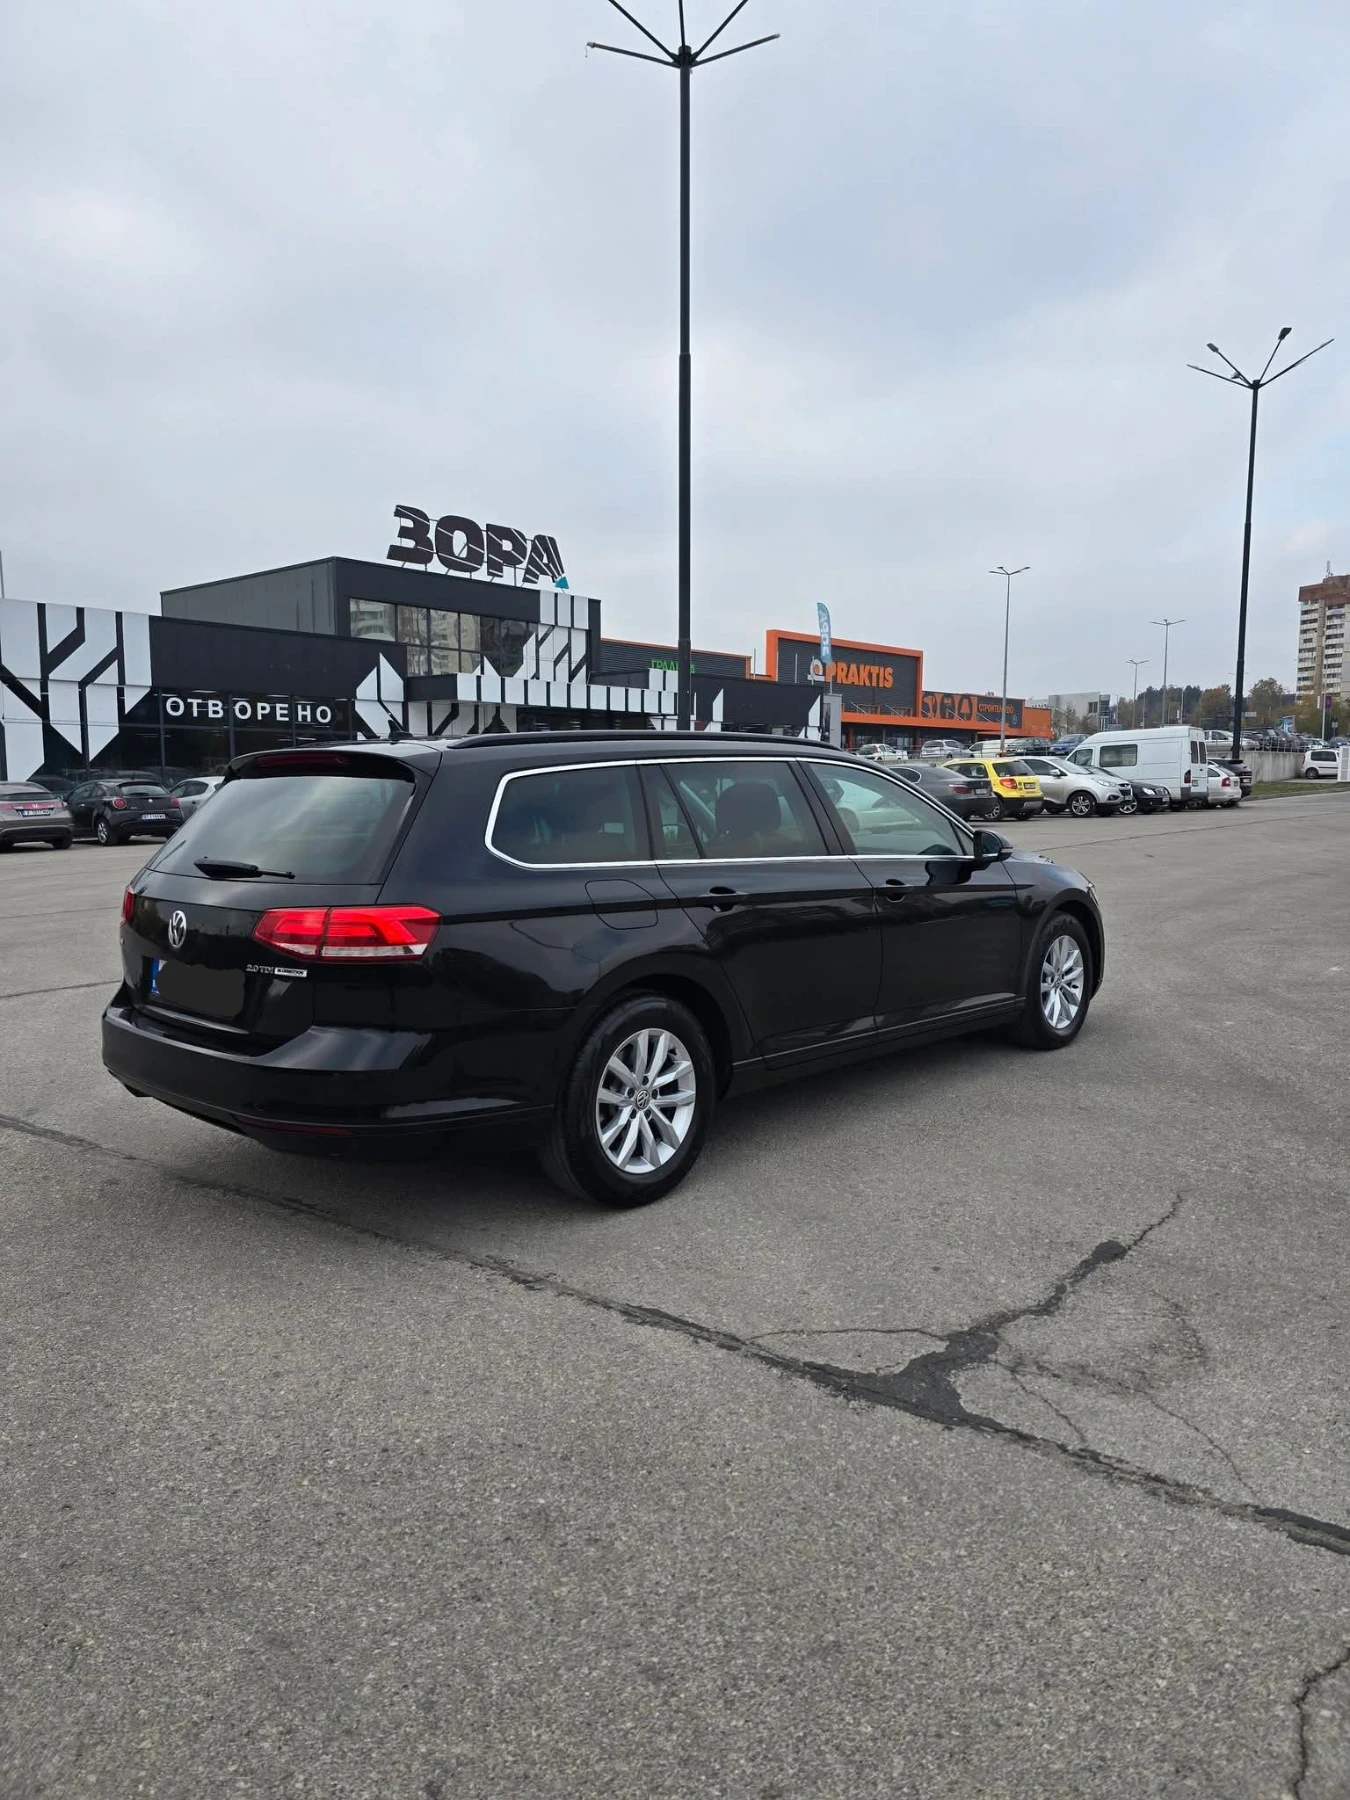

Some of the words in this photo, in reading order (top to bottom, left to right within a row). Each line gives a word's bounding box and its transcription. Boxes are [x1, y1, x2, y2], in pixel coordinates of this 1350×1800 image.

[386, 505, 569, 589] ЗОРА
[651, 659, 695, 674] ГРАДА
[825, 660, 893, 688] PRAKTIS
[165, 697, 332, 724] ОТВОРЕНО
[259, 966, 274, 974] TDI
